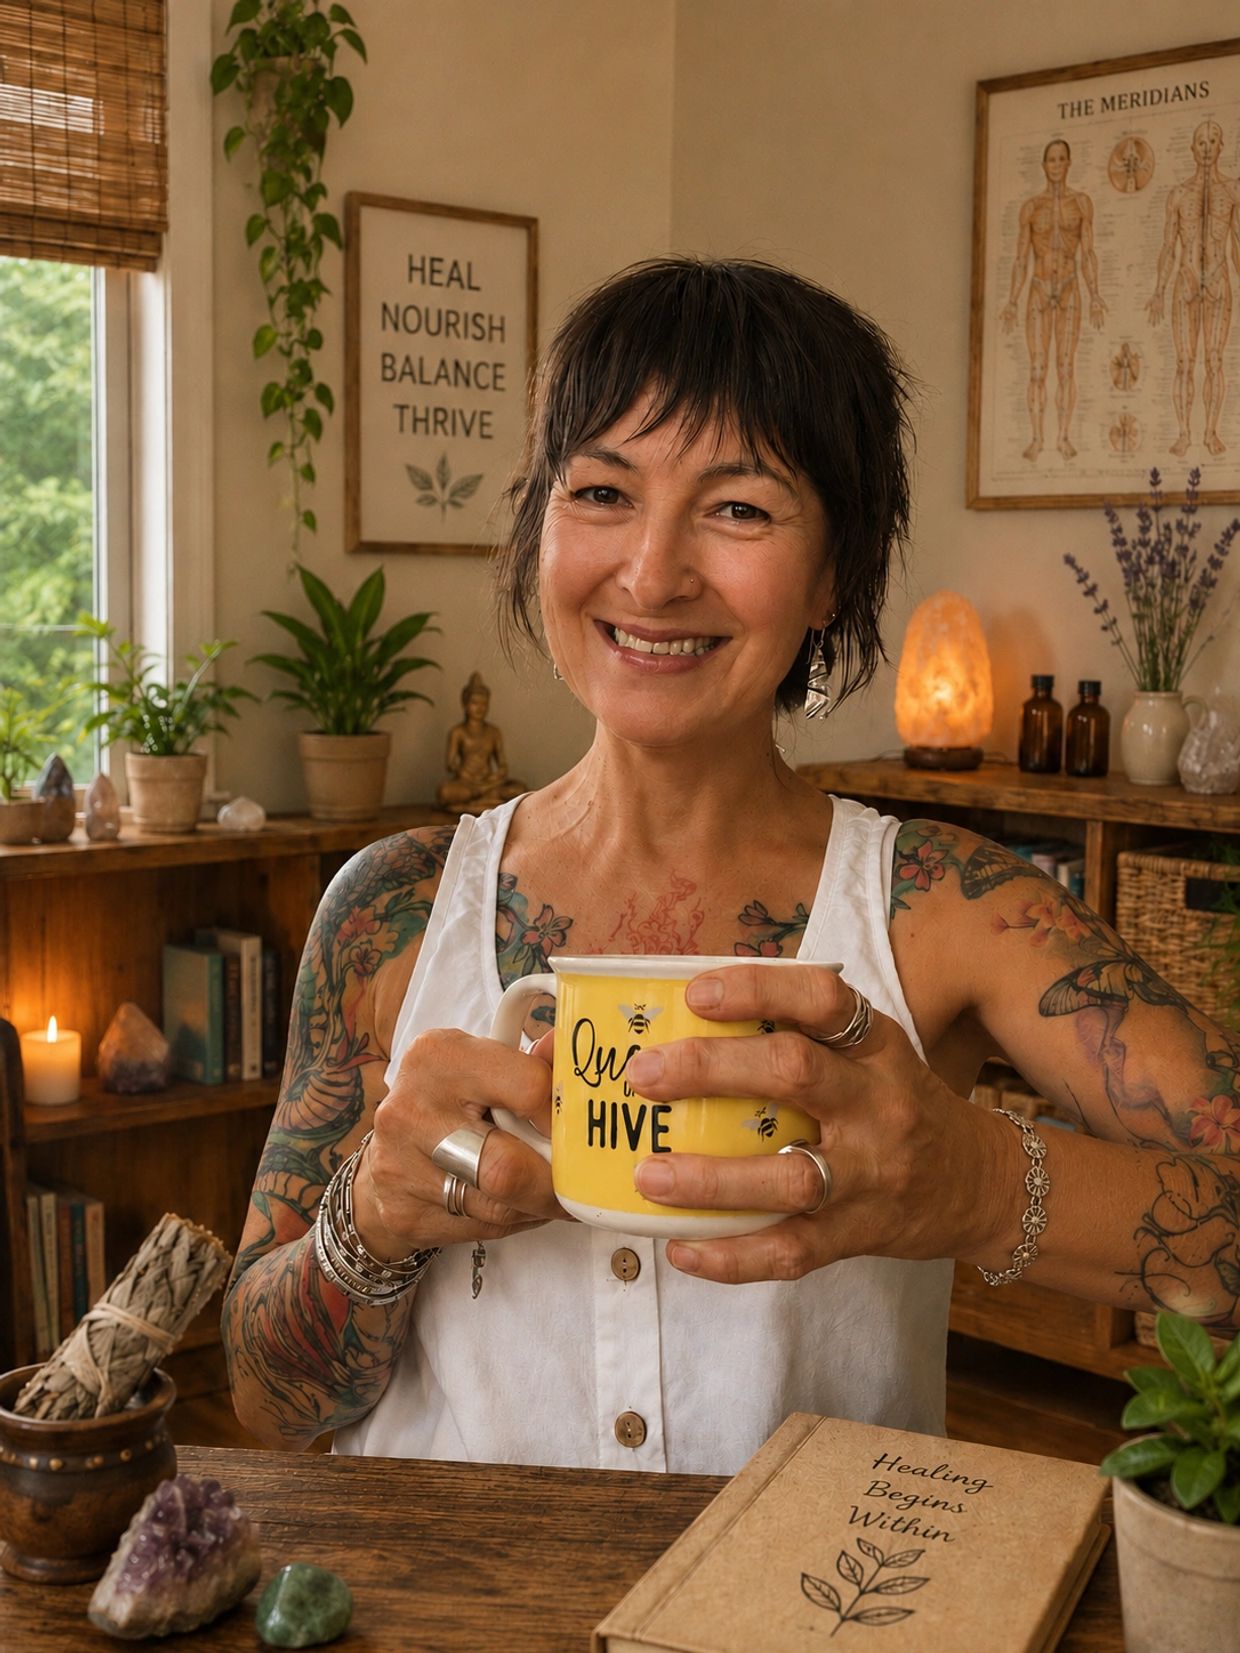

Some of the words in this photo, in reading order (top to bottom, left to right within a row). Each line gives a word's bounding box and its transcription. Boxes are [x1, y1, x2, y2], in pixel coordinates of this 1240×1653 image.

[1057, 99, 1095, 120] THE
[1100, 80, 1211, 113] MERIDIANS
[407, 253, 482, 292] HEAL
[381, 301, 506, 344] NOURISH
[380, 352, 507, 392] BALANCE
[393, 403, 494, 440] THRIVE
[587, 1098, 673, 1154] HIVE
[872, 1452, 994, 1494] Healing
[863, 1479, 968, 1514] Begins
[848, 1505, 956, 1543] Within
